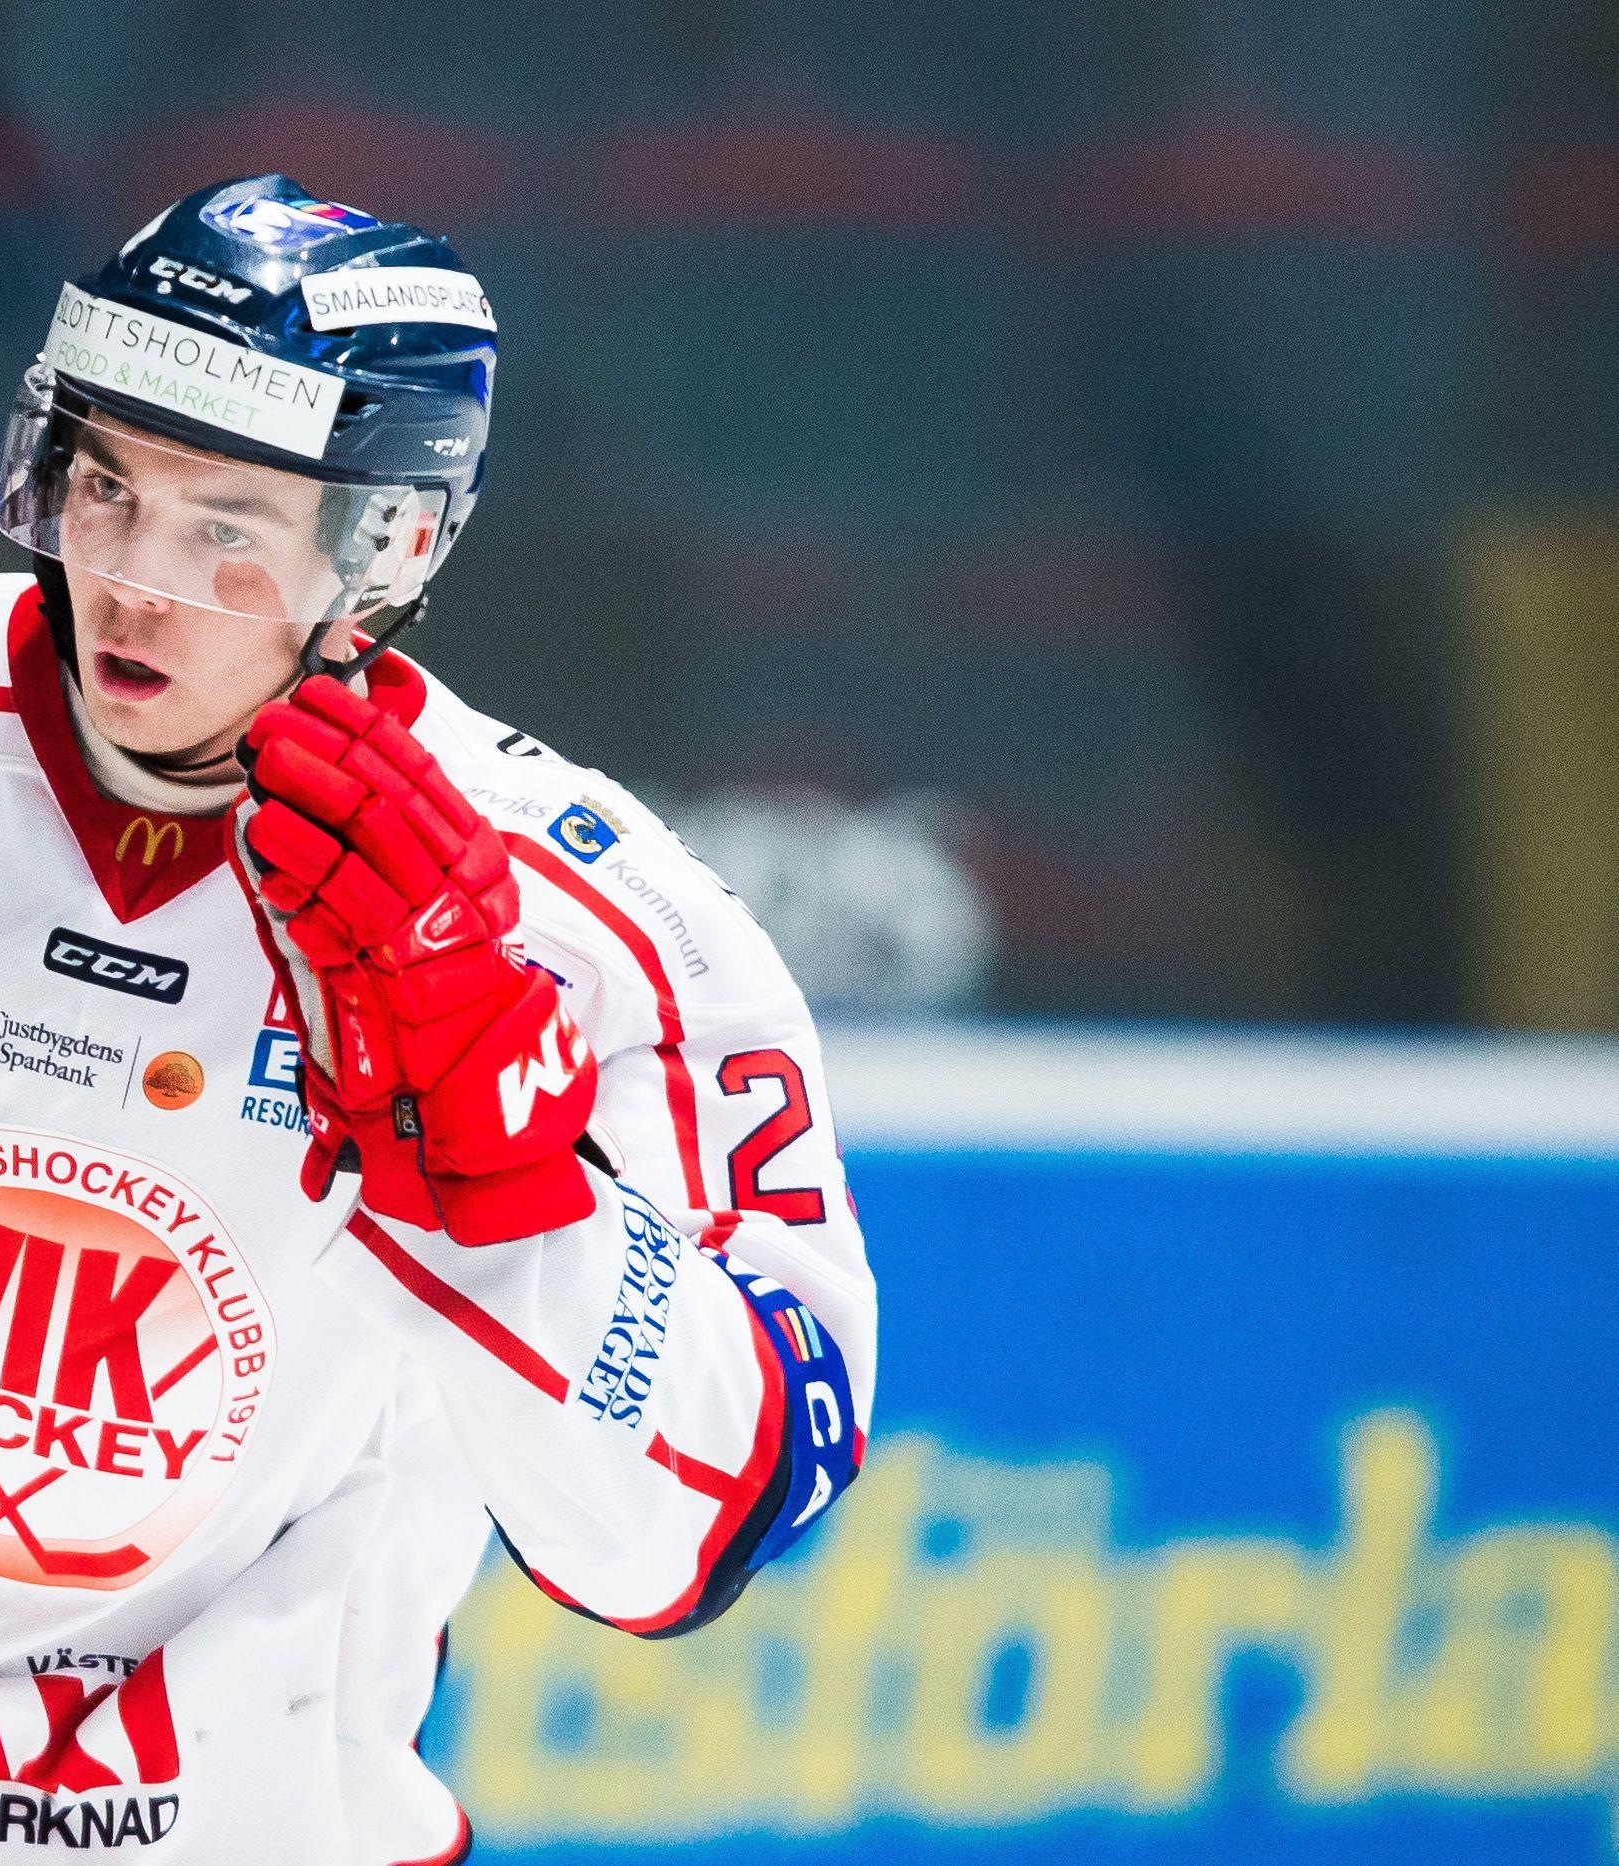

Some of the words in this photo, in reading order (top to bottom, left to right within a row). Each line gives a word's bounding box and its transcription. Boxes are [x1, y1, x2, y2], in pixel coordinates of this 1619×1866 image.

[149, 255, 254, 305] CCM
[57, 341, 108, 376] FOOD
[114, 361, 130, 386] &
[139, 370, 262, 430] MARKET
[49, 939, 182, 992] CCM
[605, 858, 711, 979] Kommun
[715, 1048, 858, 1227] 2
[187, 1233, 268, 1380] KLUBB
[577, 1199, 650, 1421] BOLAGET
[208, 1386, 262, 1464] 1971
